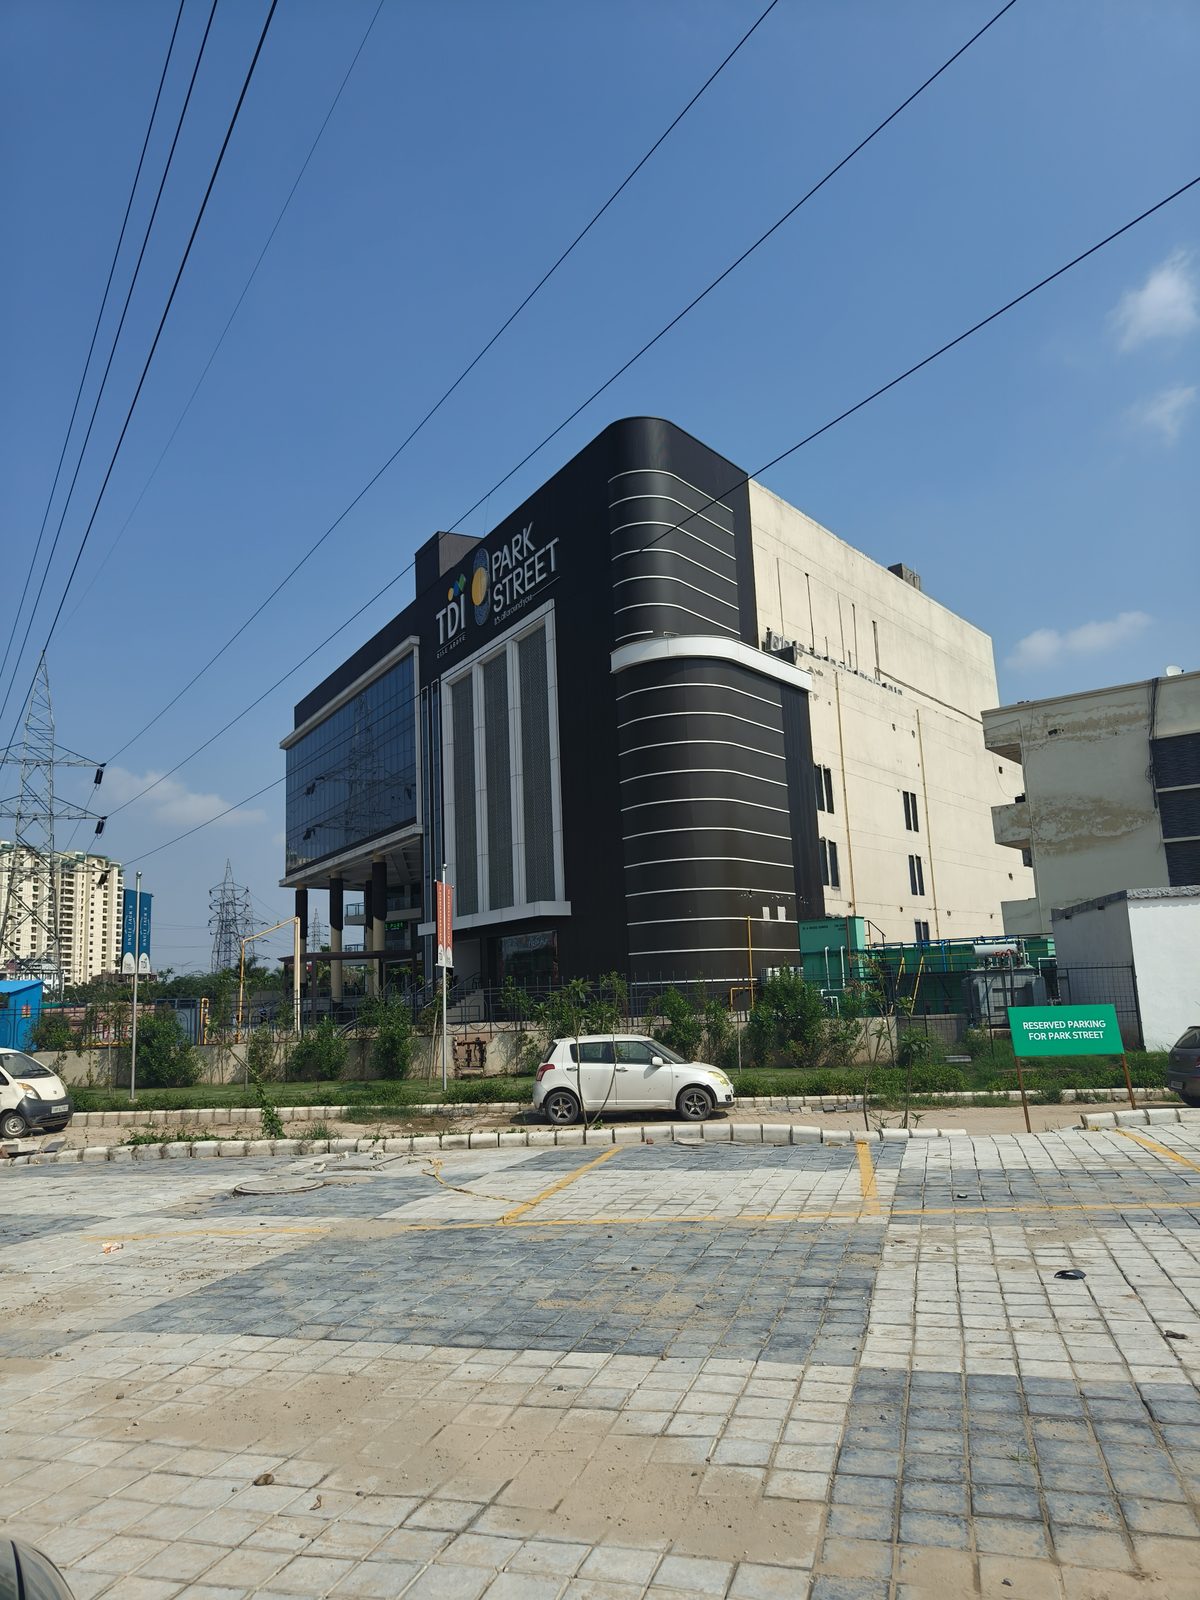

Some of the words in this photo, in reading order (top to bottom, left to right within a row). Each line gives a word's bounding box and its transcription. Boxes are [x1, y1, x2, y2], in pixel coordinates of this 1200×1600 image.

[492, 521, 536, 582] PARK
[493, 537, 560, 613] STREET
[436, 593, 466, 645] TDI
[1022, 1021, 1066, 1030] RESERVED
[1067, 1020, 1106, 1029] PARKING
[1028, 1032, 1047, 1040] FOR
[1048, 1031, 1071, 1040] PARK
[1072, 1031, 1104, 1039] STREET
